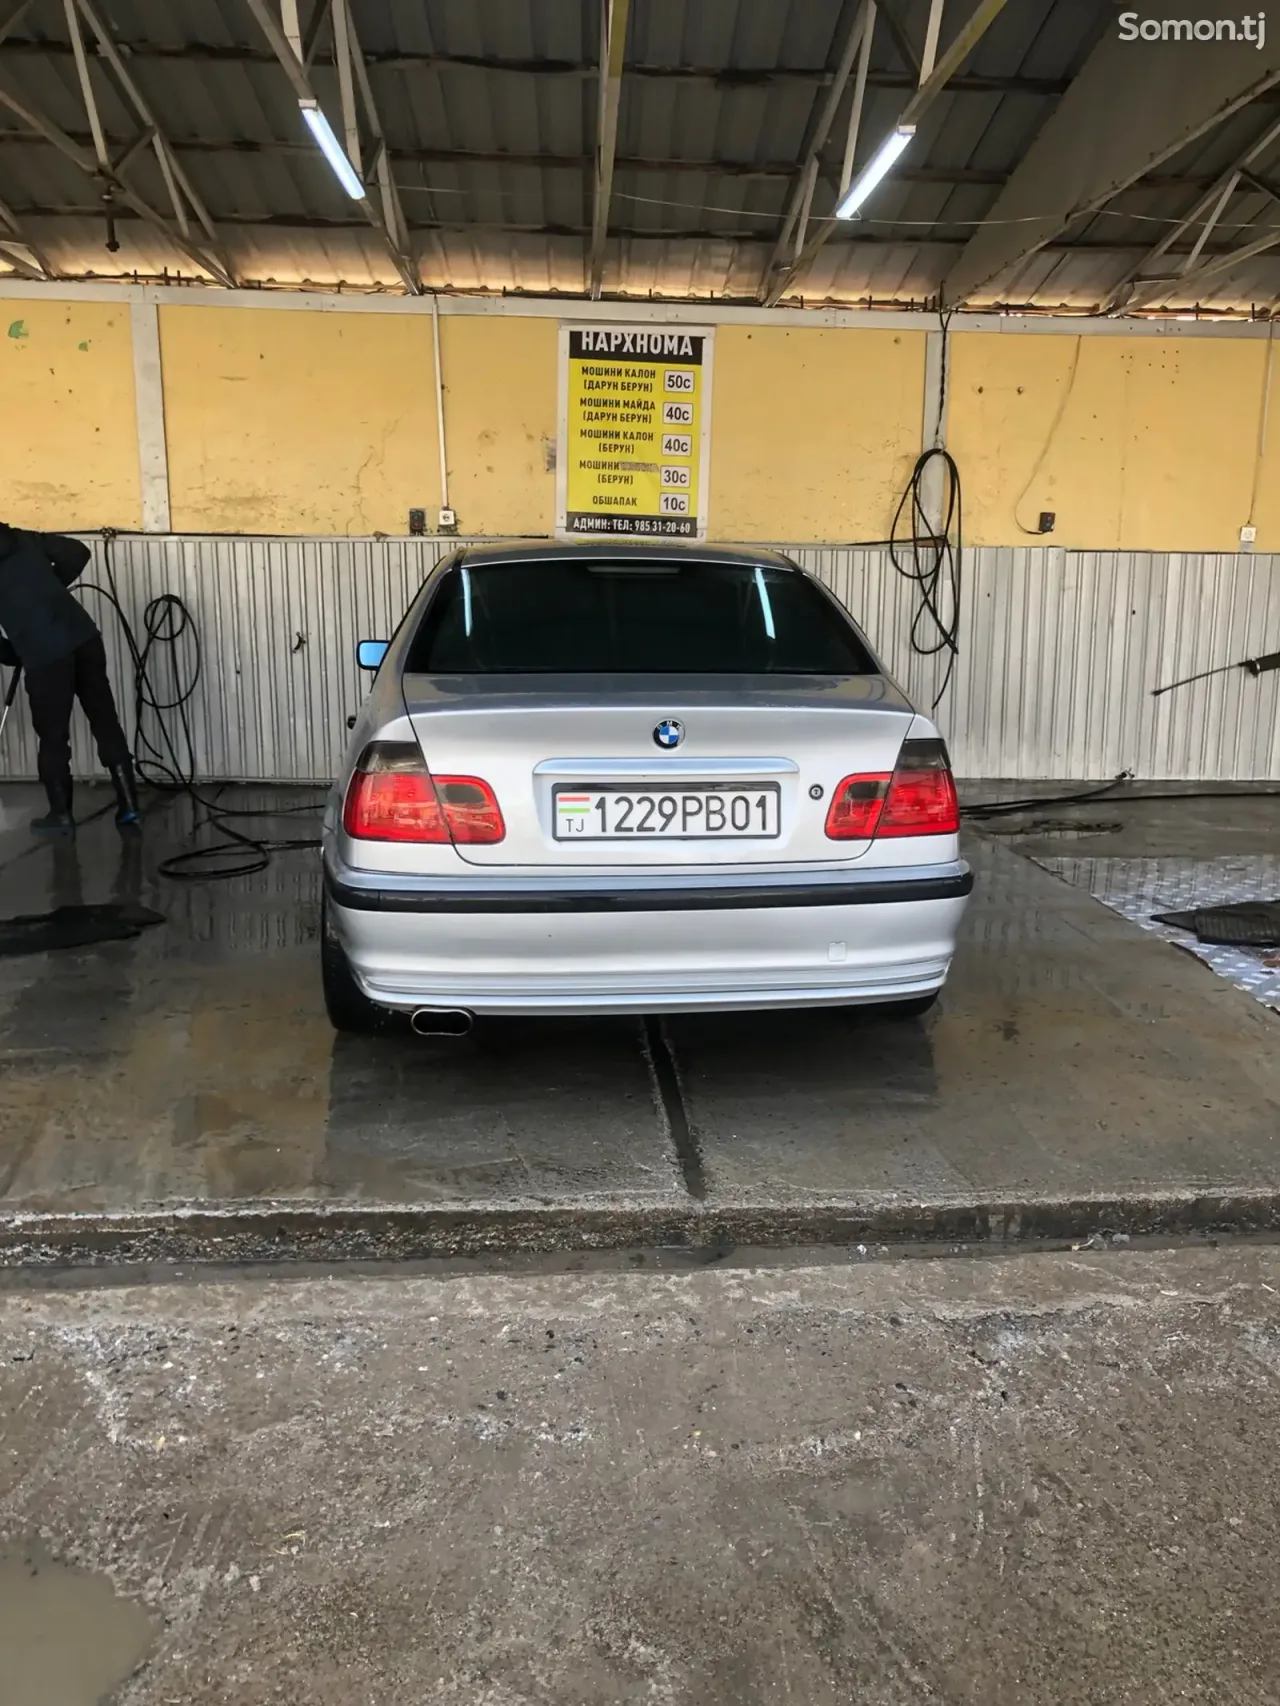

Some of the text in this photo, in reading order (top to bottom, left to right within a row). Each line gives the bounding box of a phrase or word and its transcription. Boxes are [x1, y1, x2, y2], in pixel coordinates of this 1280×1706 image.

[581, 331, 693, 356] НАРХНОМА
[581, 366, 656, 379] МОШИНИ КАЛОН
[667, 374, 691, 389] 50с
[580, 398, 656, 410] МОШИНИ МАЙДА
[666, 406, 690, 421] 40с
[580, 429, 654, 441] МОШИНИ КАЛОН
[664, 438, 688, 453] 40с
[579, 460, 620, 471] МОШИНИ
[663, 470, 687, 484] 30с
[592, 495, 638, 507] ОБШАПАК
[663, 497, 686, 511] 10с
[573, 517, 691, 533] АДМИН: ТЕЛ: 985 31-20-60
[594, 795, 767, 833] 1229PB01
[565, 818, 585, 833] TJ
